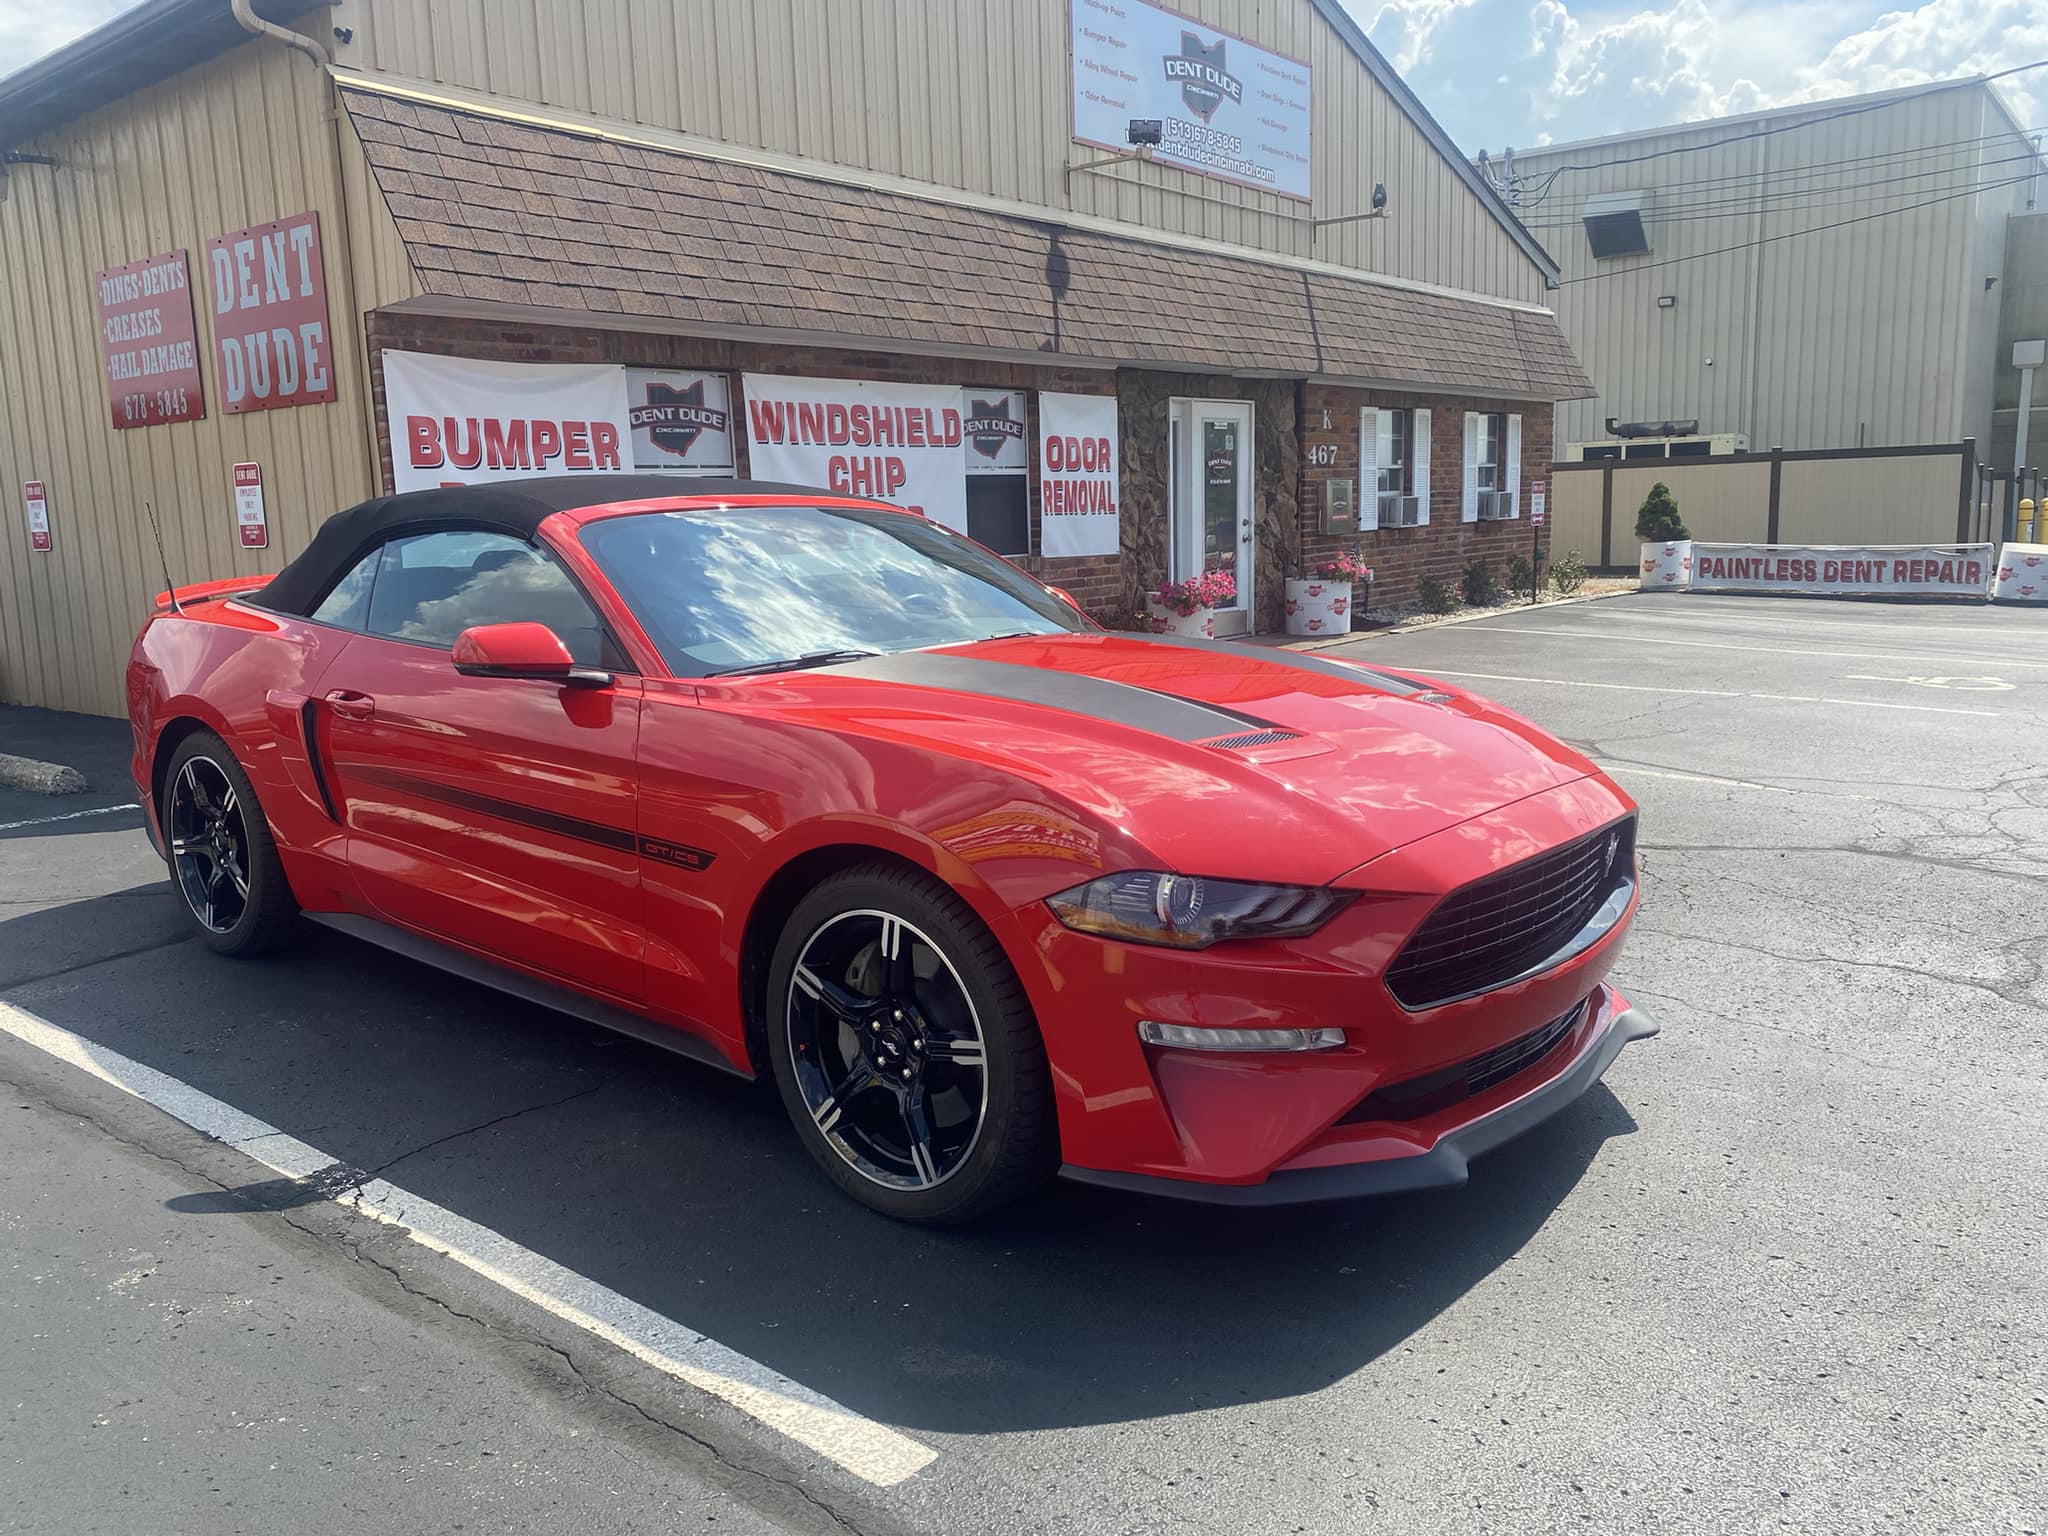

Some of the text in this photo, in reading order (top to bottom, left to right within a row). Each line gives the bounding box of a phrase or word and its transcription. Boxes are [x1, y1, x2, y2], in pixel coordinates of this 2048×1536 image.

[1166, 60, 1203, 78] DENT
[1206, 67, 1241, 99] DUDE
[1126, 129, 1275, 182] .dentdudecincinnati.com
[212, 224, 313, 314] DENT
[106, 308, 162, 343] CREASES
[111, 341, 193, 381] HAIL DAMAGE
[222, 322, 328, 402] DUDE
[630, 408, 723, 427] DENT DUDE
[749, 400, 962, 448] WINDSHIELD
[992, 420, 1022, 436] DUDE
[406, 415, 621, 471] BUMPER
[1046, 435, 1111, 472] ODOR
[1308, 445, 1338, 465] 467
[828, 455, 906, 497] CHIP
[1043, 480, 1116, 515] REMOVAL
[1699, 557, 1982, 585] PAINTLESS DENT REPAIR
